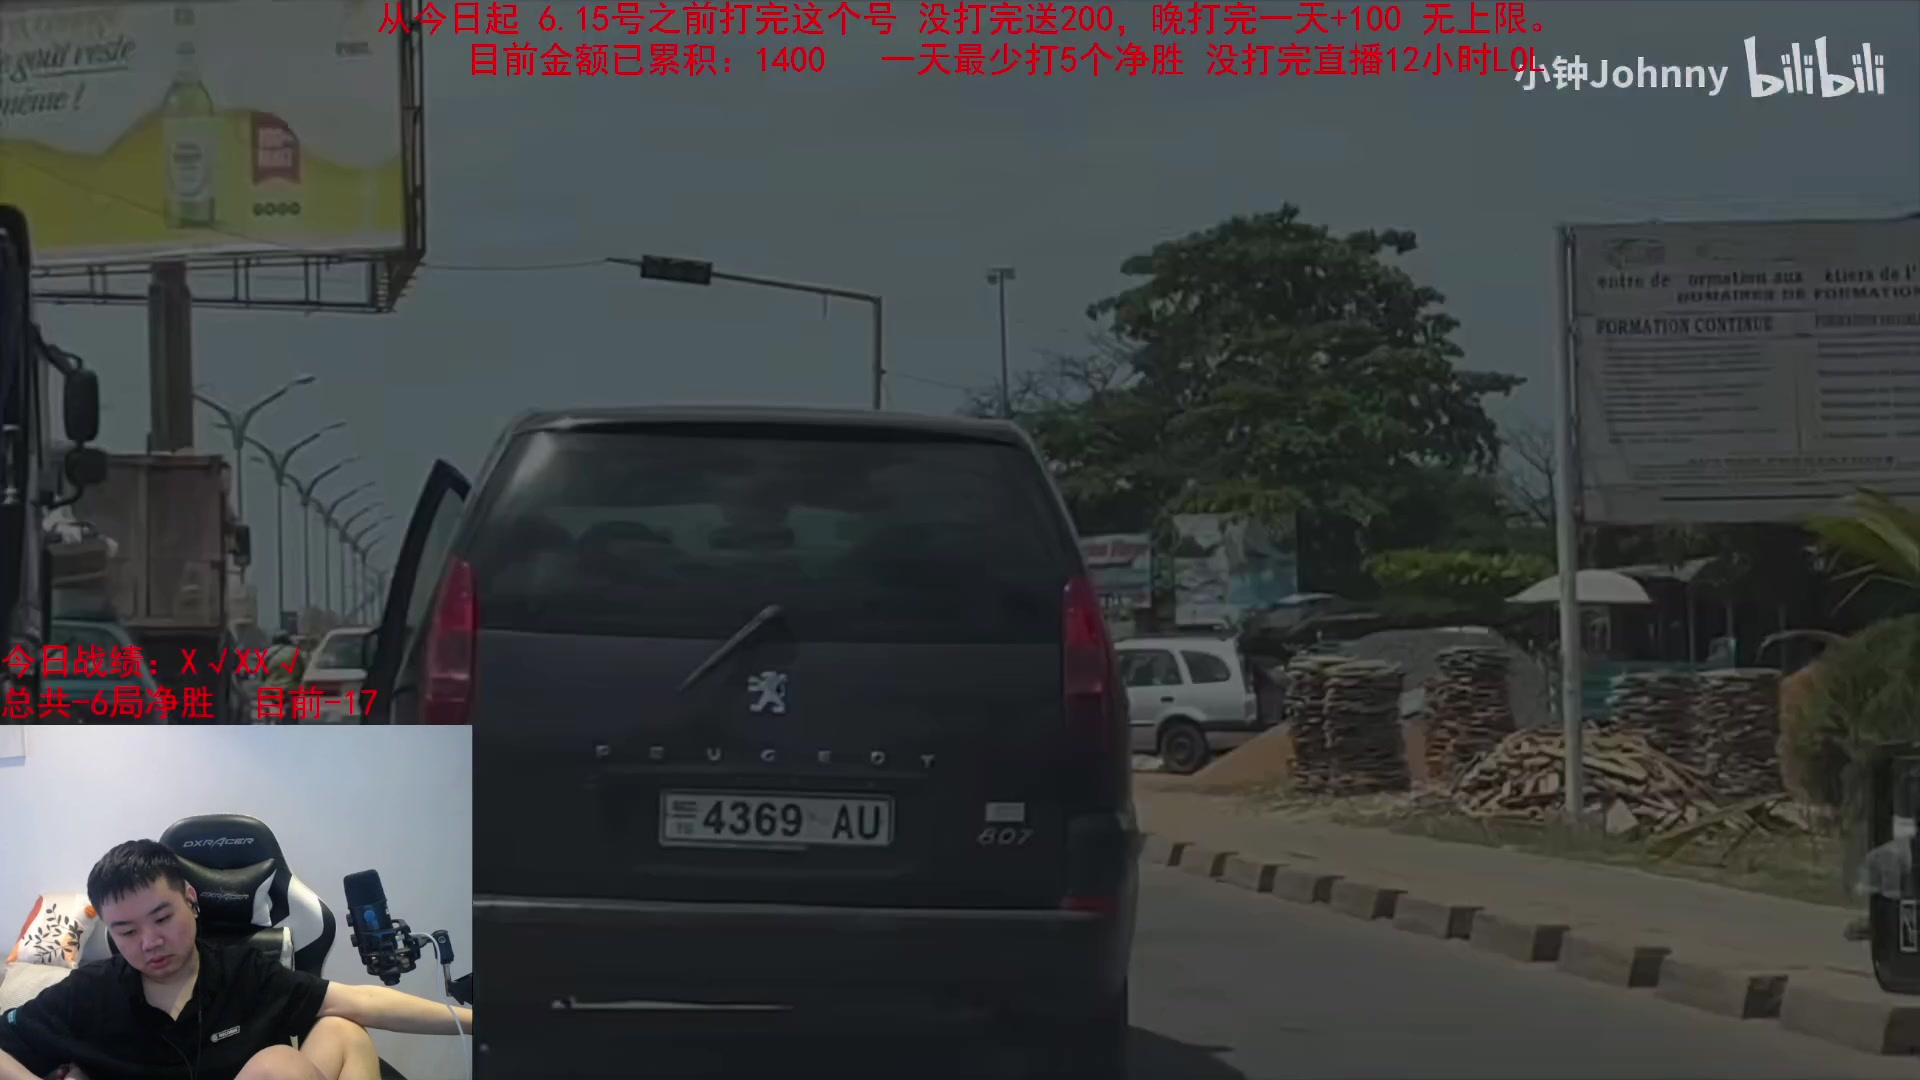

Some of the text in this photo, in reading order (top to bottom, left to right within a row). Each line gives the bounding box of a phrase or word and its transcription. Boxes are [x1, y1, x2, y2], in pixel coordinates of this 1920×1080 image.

[73, 34, 136, 66] reste
[1596, 314, 1773, 336] FORMATION CONTINUE
[595, 744, 935, 769] PEUGEOT
[702, 800, 882, 841] 4369 AU
[183, 837, 254, 848] DXRACER
[976, 826, 1034, 846] 807
